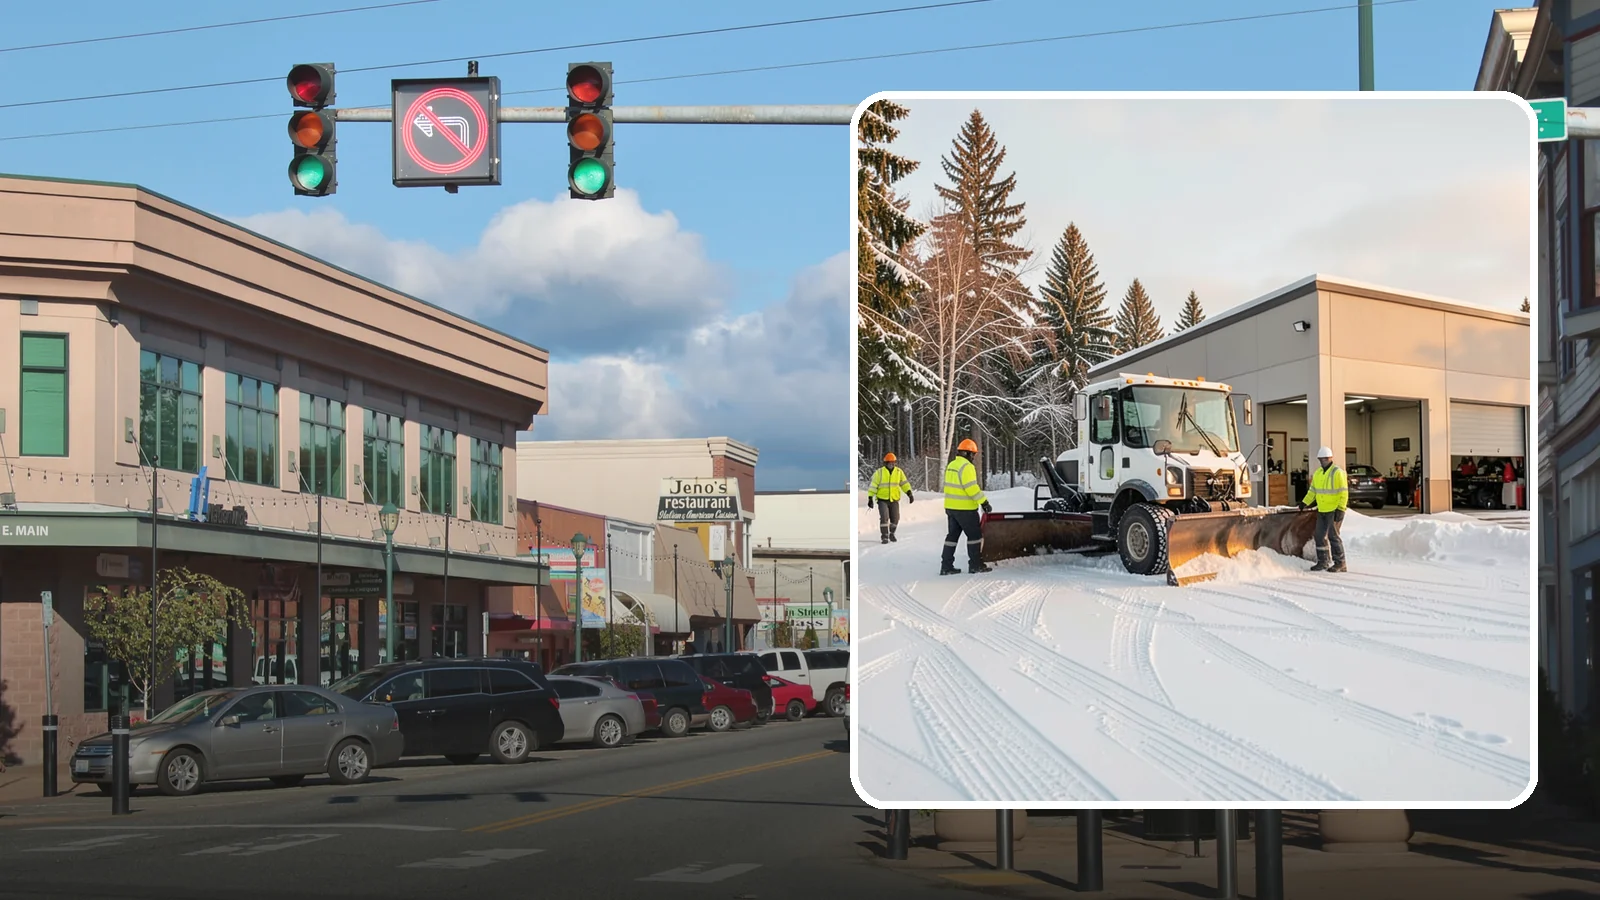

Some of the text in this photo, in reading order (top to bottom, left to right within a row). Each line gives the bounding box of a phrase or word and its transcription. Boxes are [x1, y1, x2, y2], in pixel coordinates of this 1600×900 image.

[669, 479, 727, 495] Jeno's
[664, 496, 731, 509] restaurant
[686, 509, 714, 519] American
[715, 509, 737, 519] Cuisine
[2, 525, 49, 536] E. MAIN
[797, 607, 829, 617] Street
